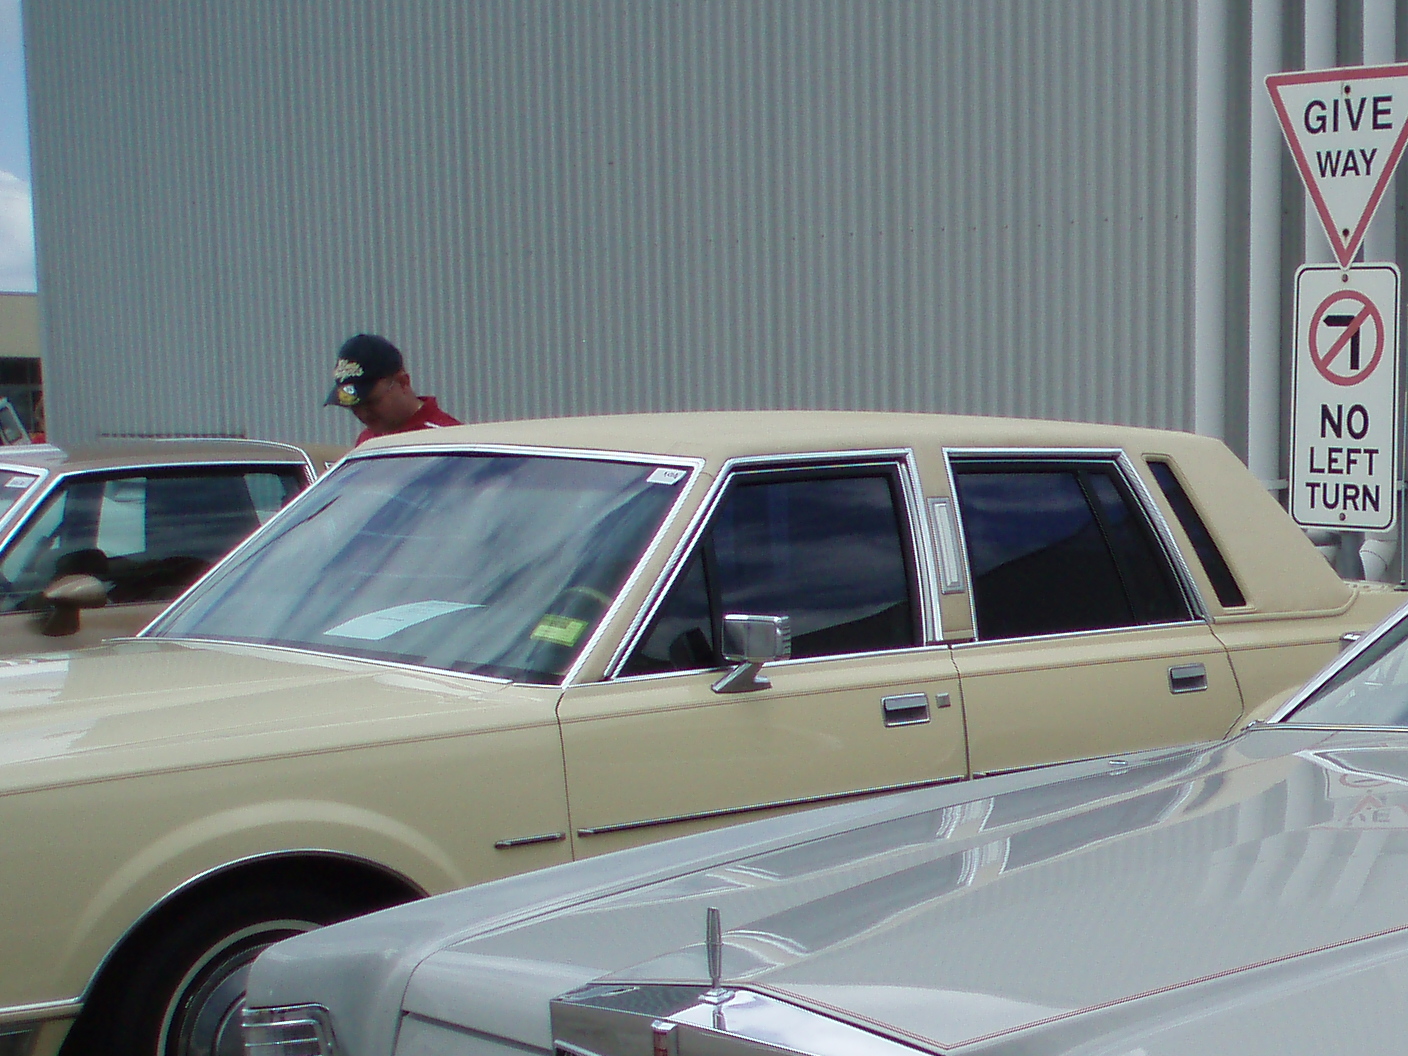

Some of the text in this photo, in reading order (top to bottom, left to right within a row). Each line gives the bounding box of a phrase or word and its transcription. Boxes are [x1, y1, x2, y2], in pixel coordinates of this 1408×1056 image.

[1304, 95, 1393, 134] GIVE
[1316, 148, 1378, 178] WAY
[1320, 403, 1370, 440] NO
[1309, 447, 1379, 476] LEFT
[1306, 482, 1381, 512] TURN
